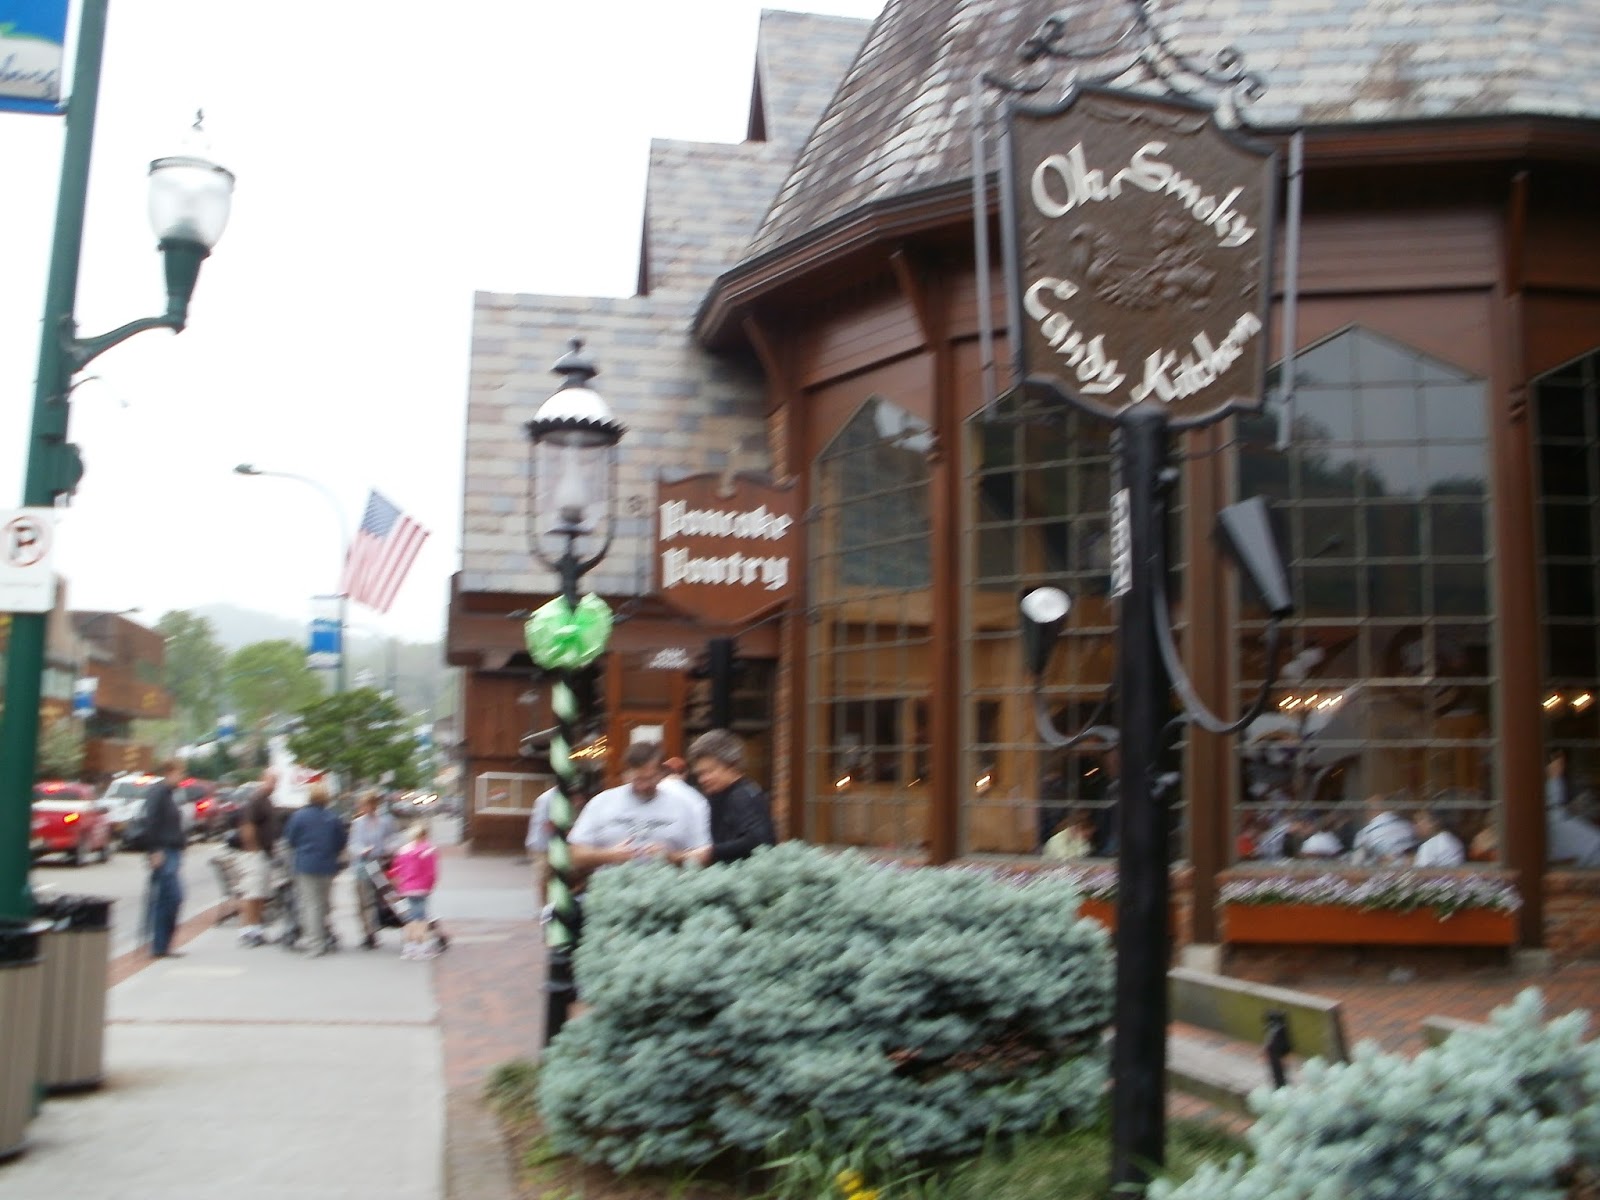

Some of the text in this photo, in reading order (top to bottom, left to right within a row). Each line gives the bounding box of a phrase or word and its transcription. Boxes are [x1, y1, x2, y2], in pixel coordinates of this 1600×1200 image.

[1109, 141, 1257, 247] Smoky
[1023, 276, 1262, 401] Candy Kitchen
[659, 499, 794, 541] Pancake
[660, 547, 790, 591] Pantry
